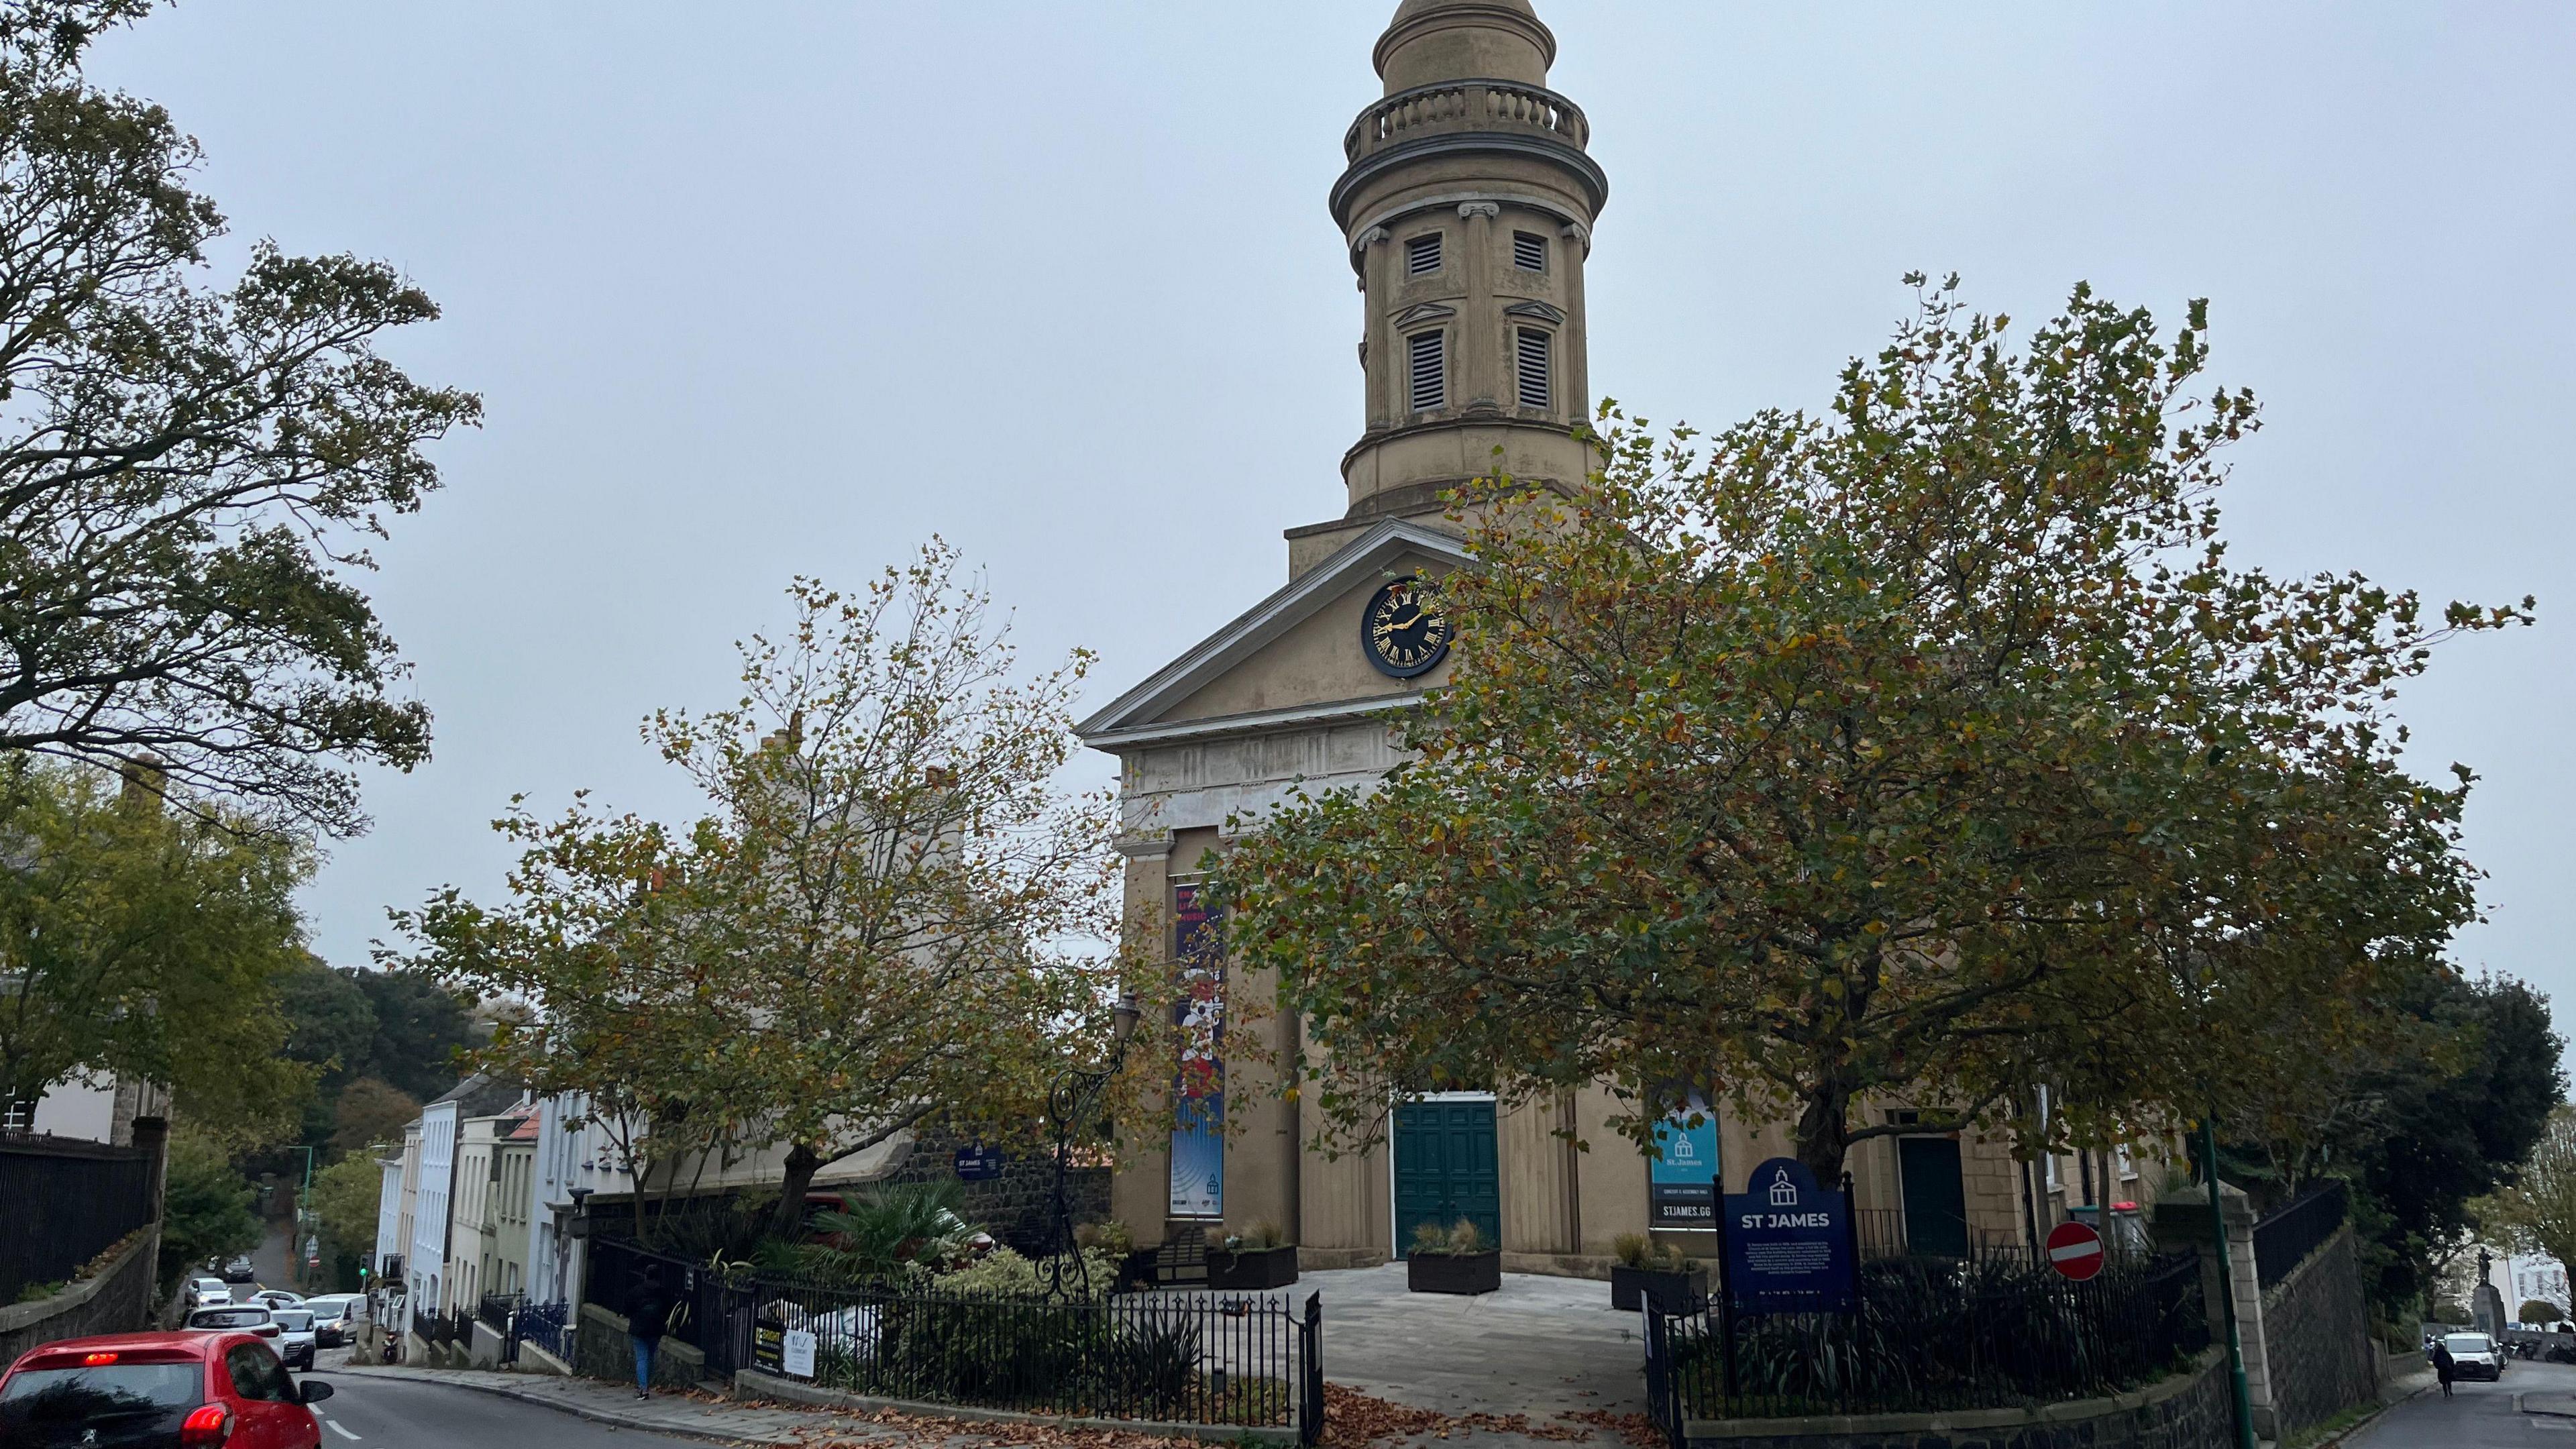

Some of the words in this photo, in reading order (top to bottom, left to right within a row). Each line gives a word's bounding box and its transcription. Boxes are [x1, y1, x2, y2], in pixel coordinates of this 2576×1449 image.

[1663, 1205, 1711, 1217] STJAMES.GG
[1741, 1214, 1764, 1229] ST
[1768, 1213, 1829, 1228] JAMES
